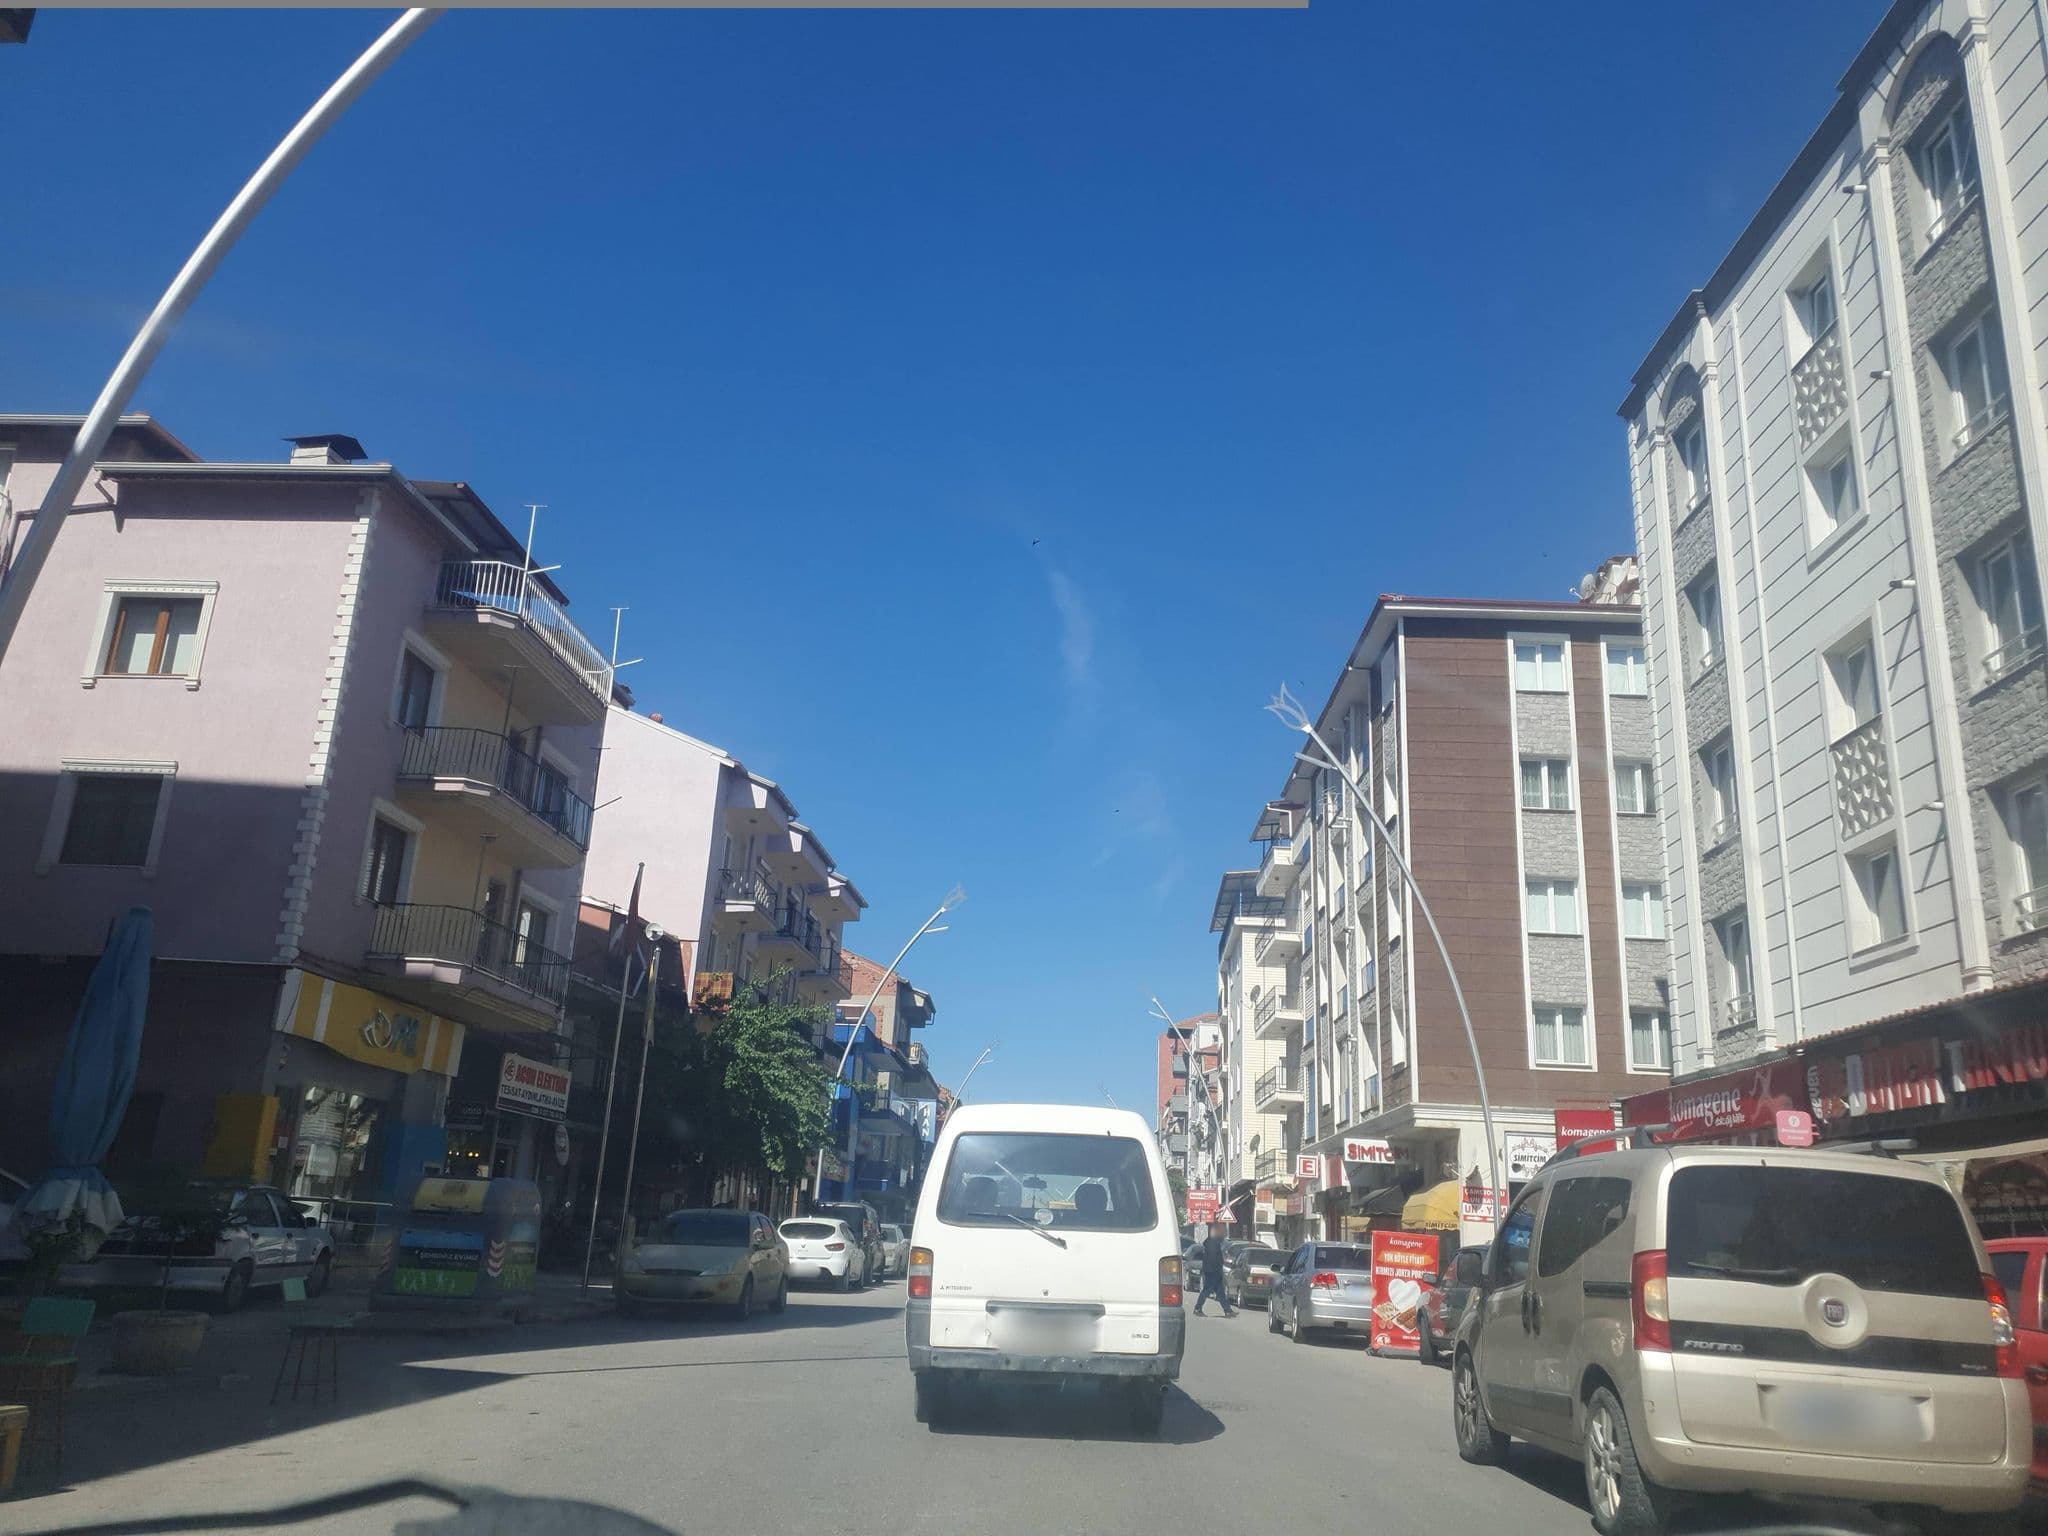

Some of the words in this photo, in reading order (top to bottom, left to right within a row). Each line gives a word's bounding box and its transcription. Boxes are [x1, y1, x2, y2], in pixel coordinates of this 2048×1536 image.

[1668, 1088, 1741, 1127] komagene
[921, 1107, 931, 1136] HAN
[1302, 1160, 1313, 1173] E
[1389, 1237, 1423, 1248] komagene
